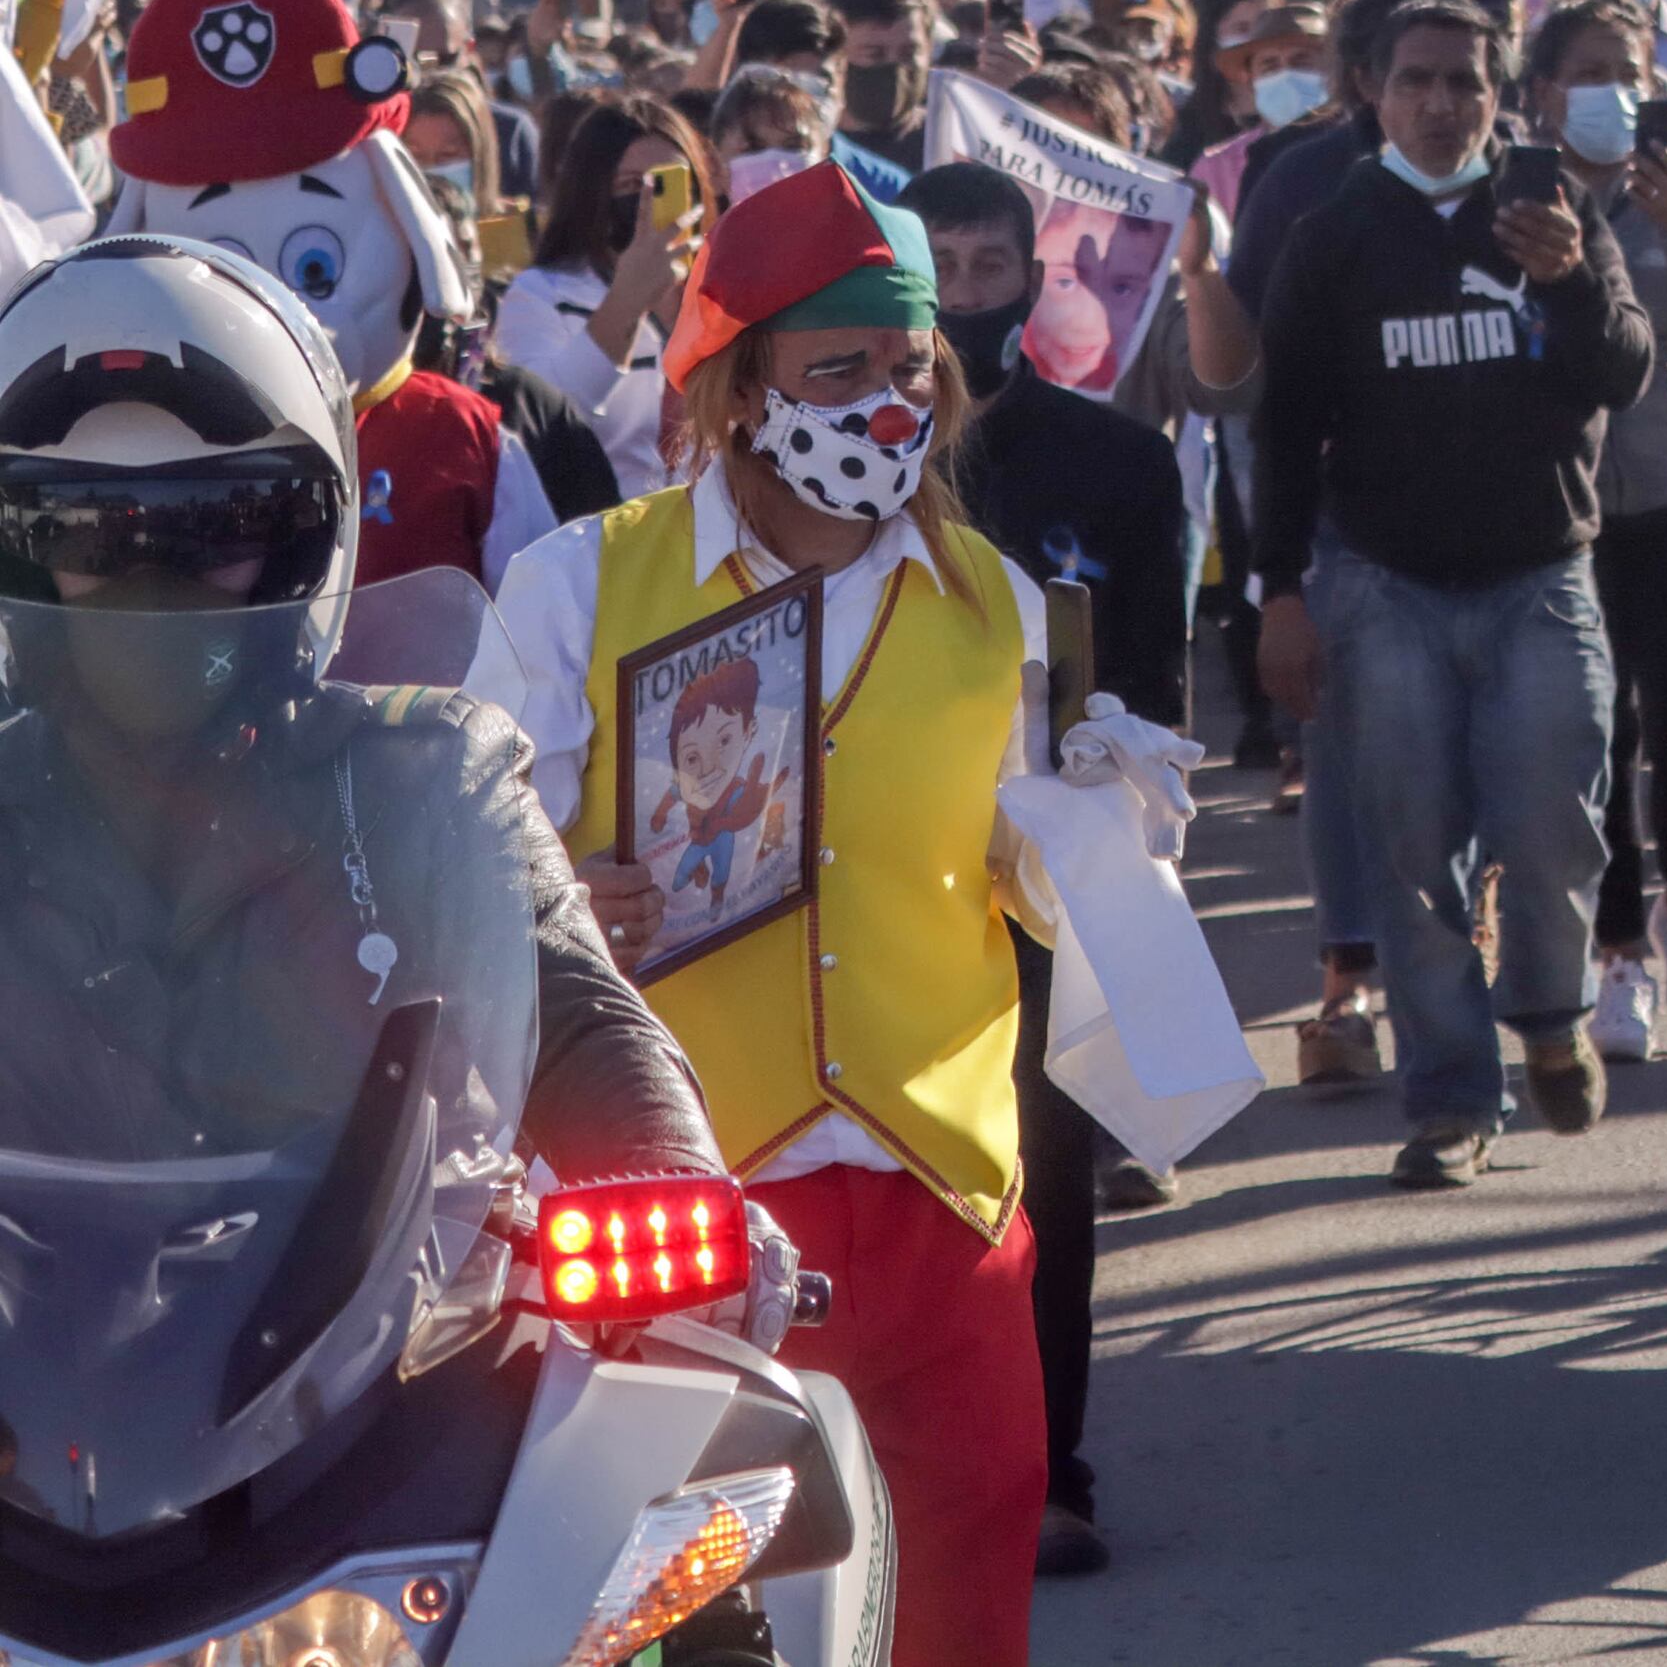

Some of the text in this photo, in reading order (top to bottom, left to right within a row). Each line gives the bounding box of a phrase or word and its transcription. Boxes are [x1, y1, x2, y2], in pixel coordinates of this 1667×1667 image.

[979, 138, 1155, 215] PARA TOMÁS
[1381, 310, 1516, 369] PUMA
[635, 595, 808, 716] TOMASITO
